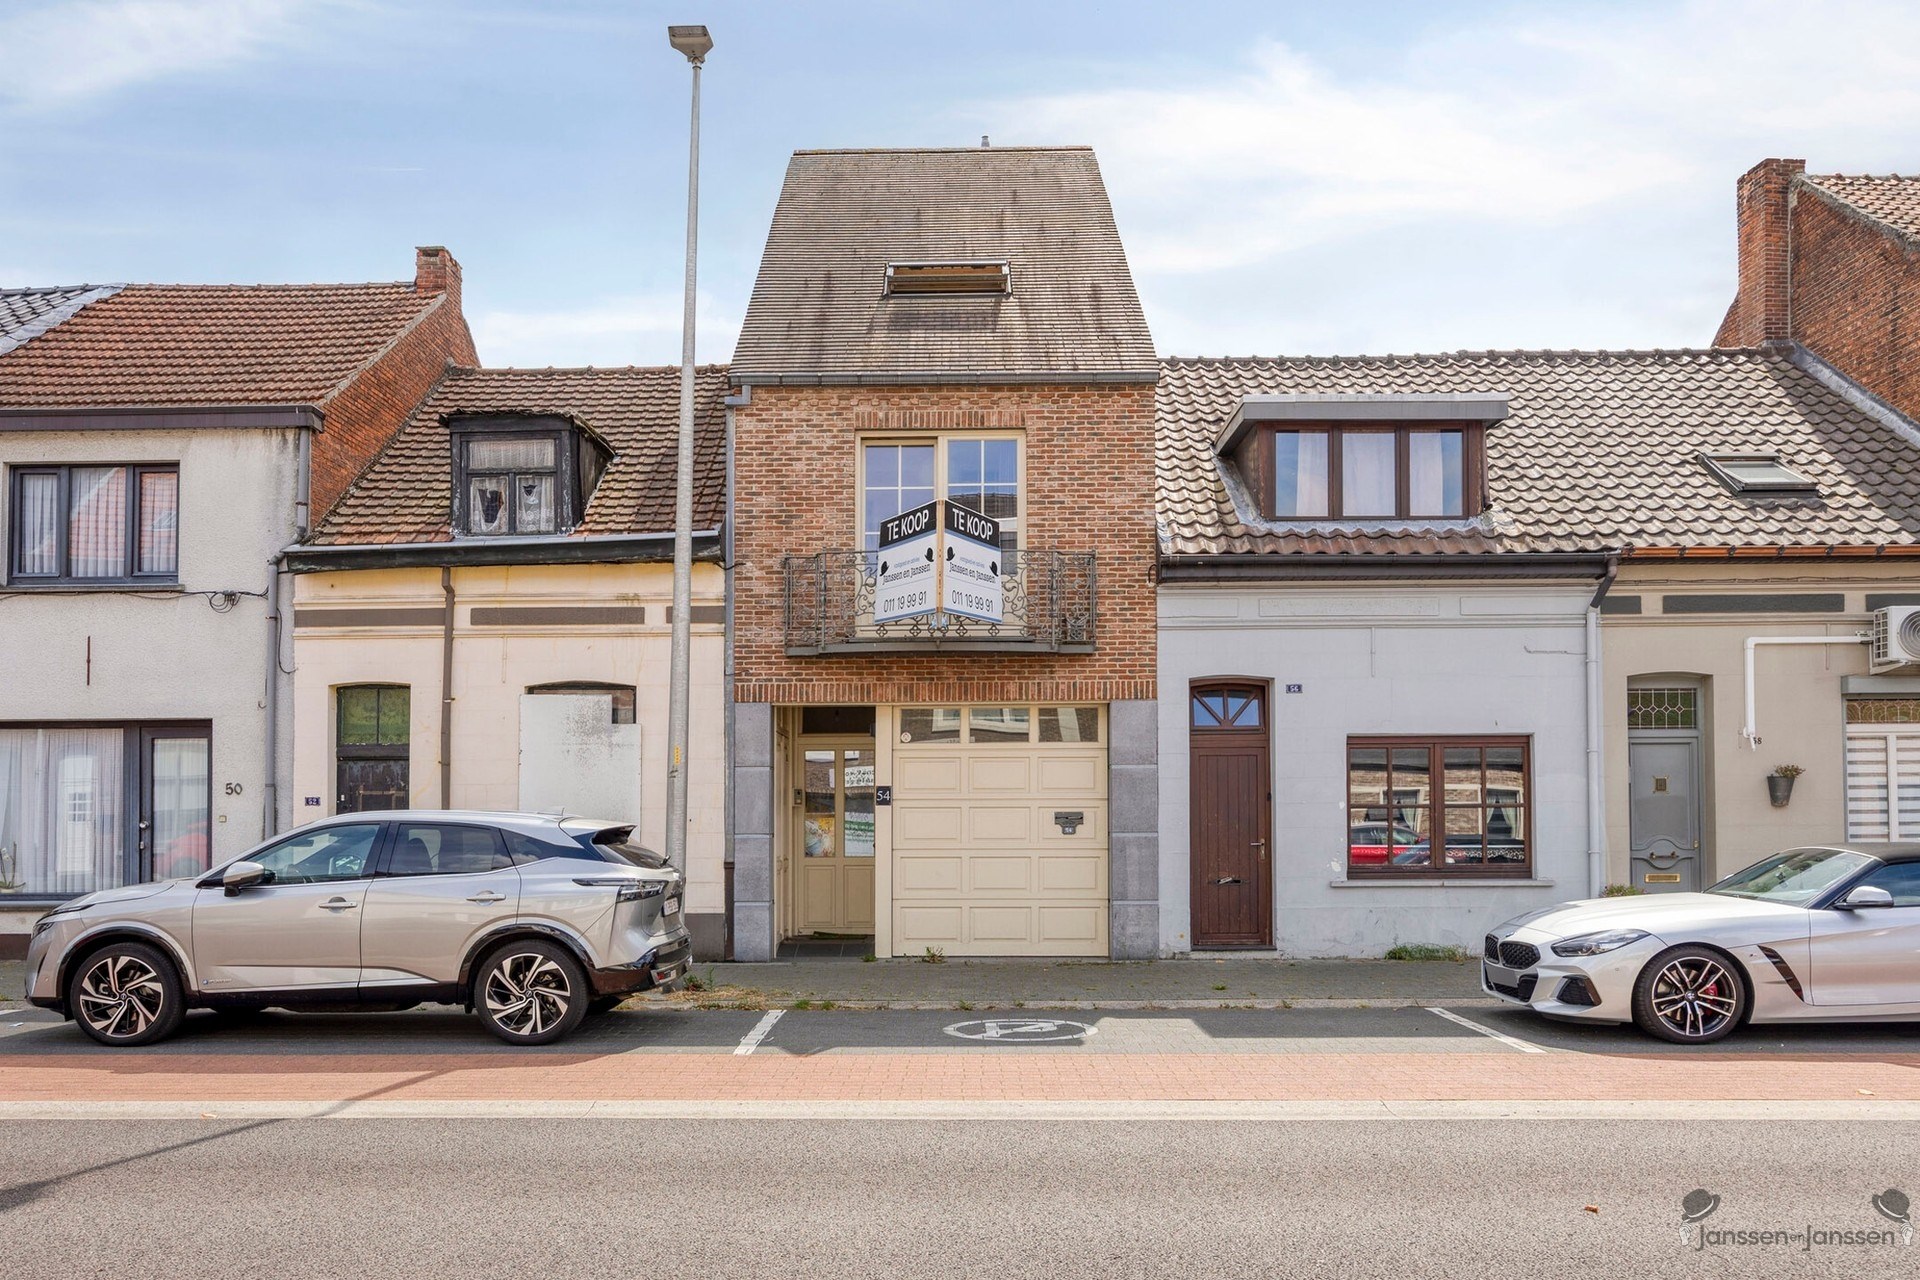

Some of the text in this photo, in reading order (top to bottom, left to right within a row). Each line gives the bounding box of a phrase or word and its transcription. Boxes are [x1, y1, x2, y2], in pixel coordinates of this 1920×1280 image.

[887, 509, 929, 541] TE KOOP
[952, 508, 993, 540] TE KOOP
[882, 571, 903, 585] Janssen
[903, 569, 910, 578] en
[910, 563, 931, 578] Janssen
[949, 562, 969, 576] Janssen
[969, 569, 976, 578] en
[976, 570, 996, 584] Janssen
[883, 590, 927, 613] 011 19 99 91
[952, 590, 994, 613] 011 19 99 91
[225, 782, 243, 795] 50
[877, 790, 891, 801] 54
